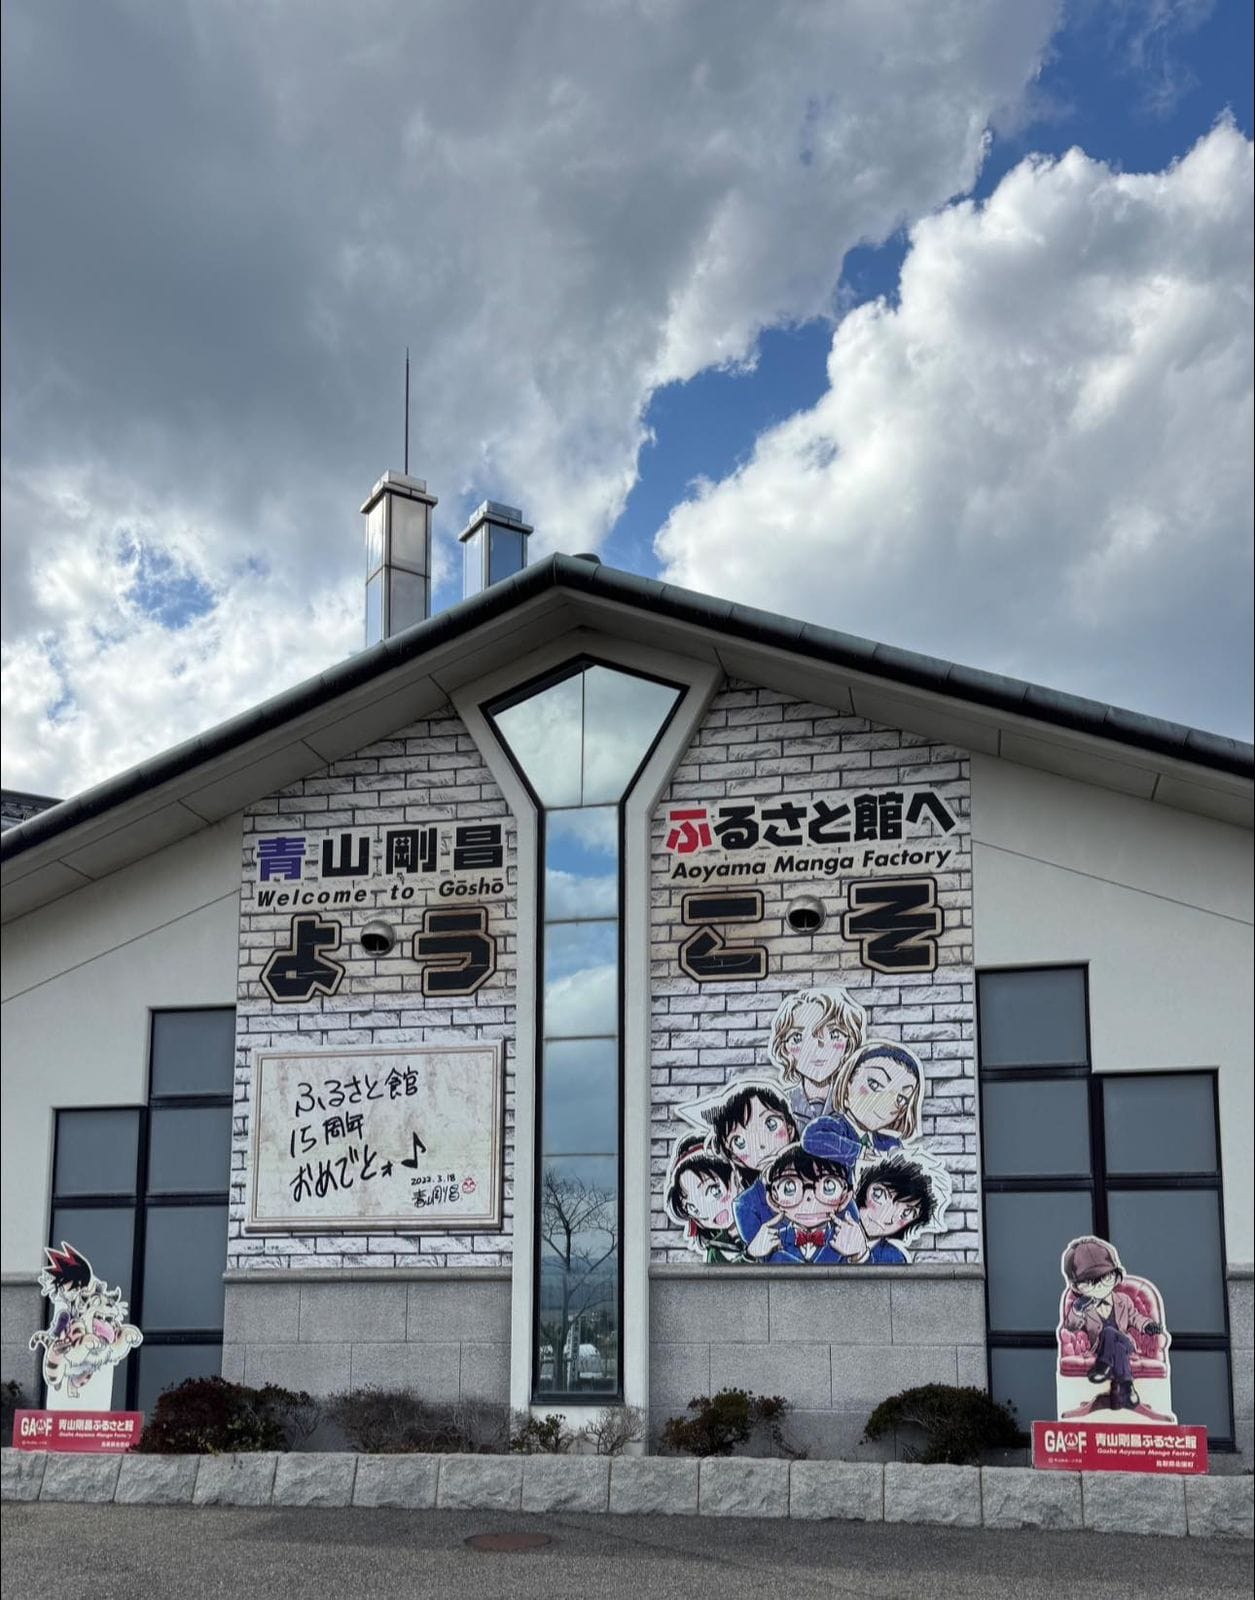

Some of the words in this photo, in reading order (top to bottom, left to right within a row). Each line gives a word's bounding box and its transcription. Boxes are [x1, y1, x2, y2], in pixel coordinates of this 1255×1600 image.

[666, 792, 956, 854] ふるさと館へ
[257, 824, 503, 881] 青山剛昌
[672, 861, 766, 882] Aoyama
[773, 854, 854, 875] Manga
[862, 850, 951, 868] Factory
[258, 889, 367, 907] Welcome
[390, 885, 415, 900] to
[295, 1066, 419, 1117] ふるさと館
